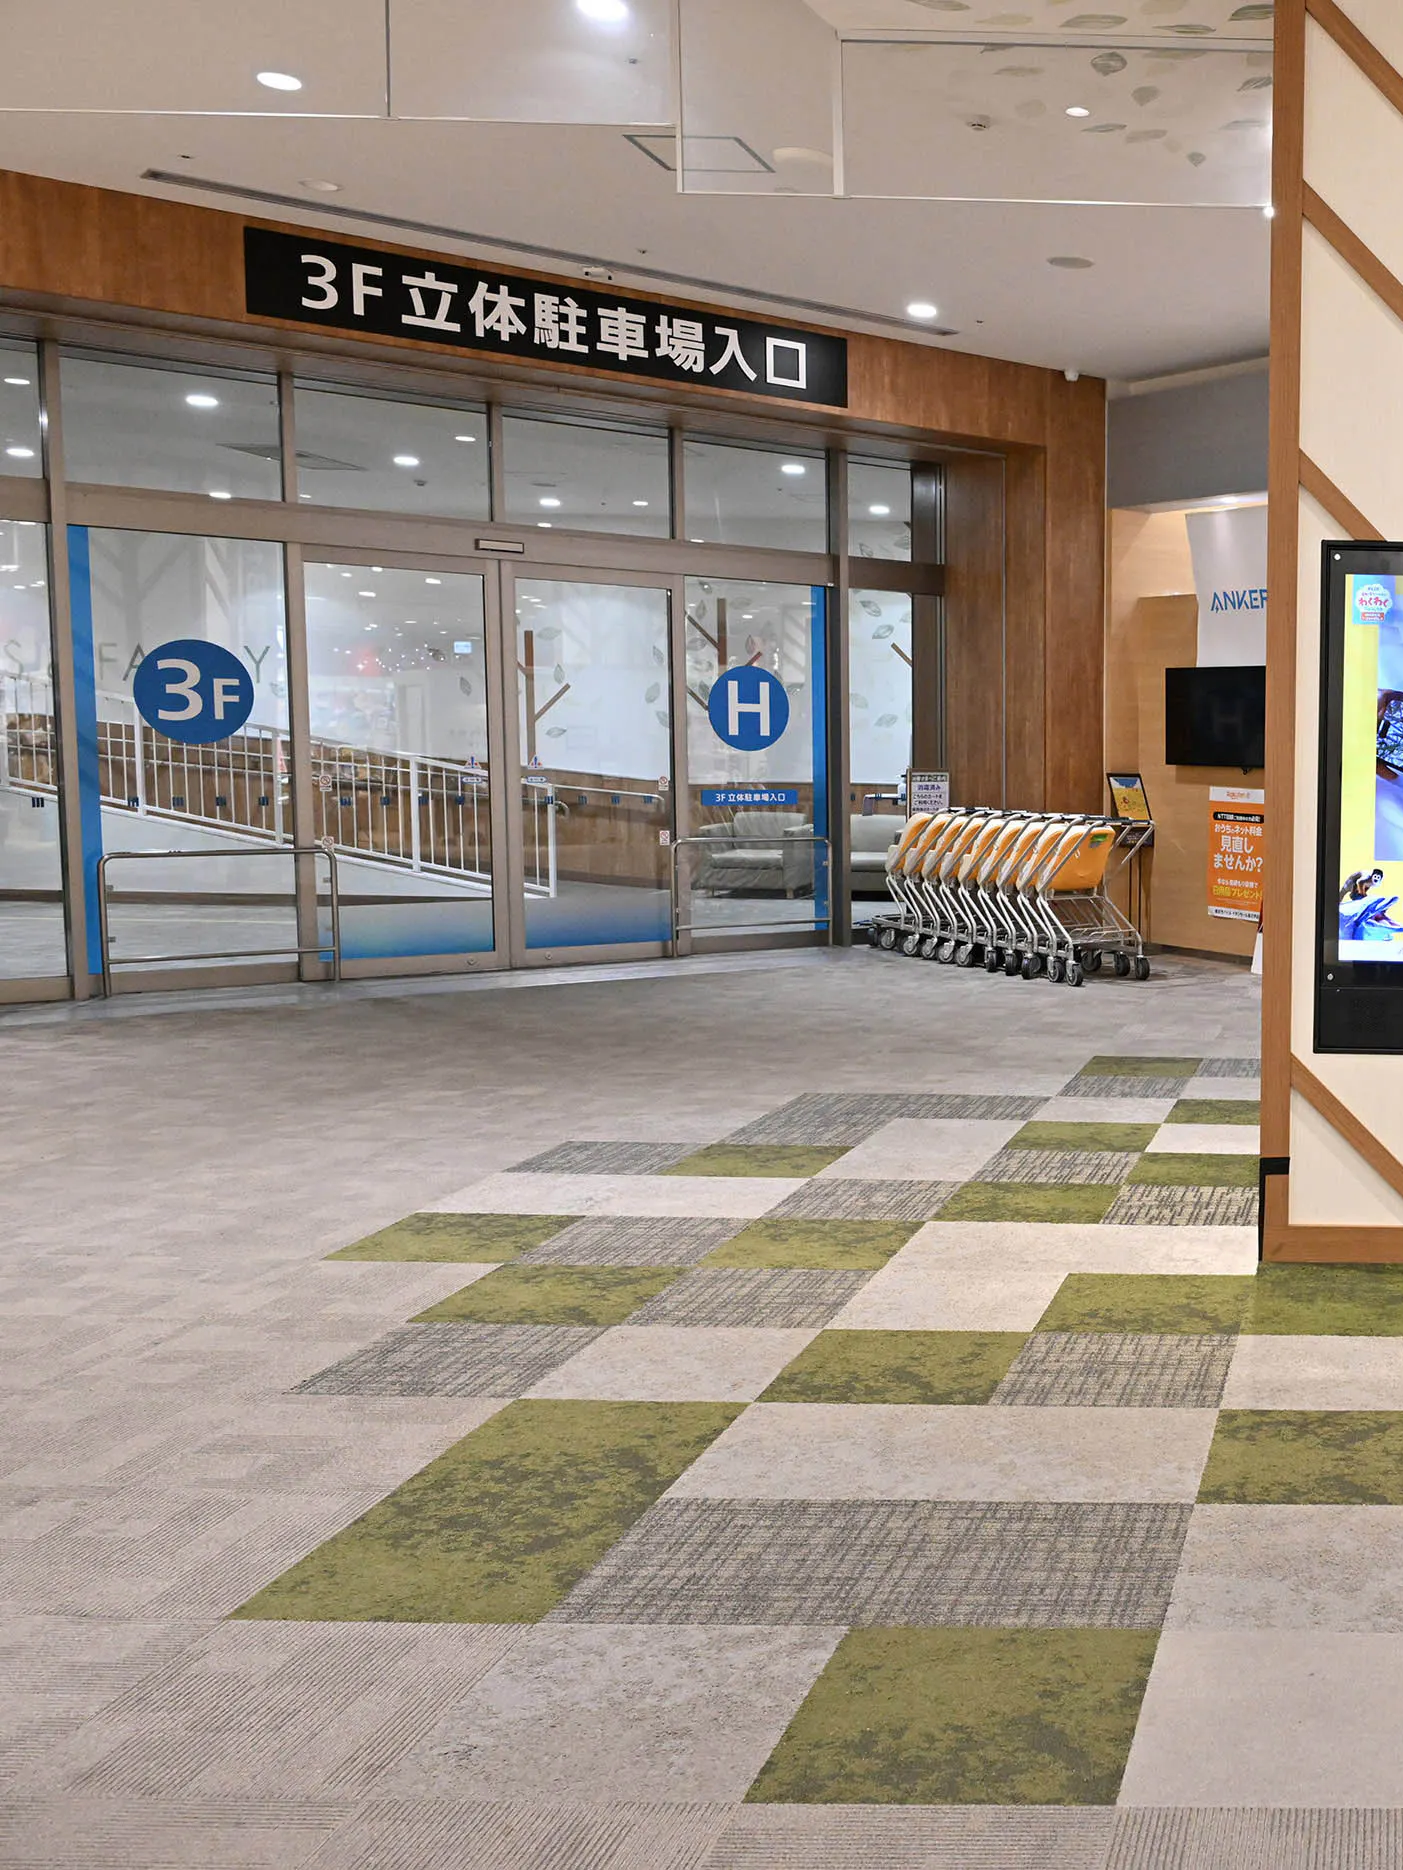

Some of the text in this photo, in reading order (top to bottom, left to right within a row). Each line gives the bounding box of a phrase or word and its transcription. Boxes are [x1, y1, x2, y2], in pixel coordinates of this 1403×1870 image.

[300, 254, 807, 390] 3F 立体駐車場入口
[156, 658, 241, 721] 3F
[727, 680, 771, 737] H
[715, 793, 786, 803] 3F 立体駐車場入口
[1213, 853, 1264, 873] ませんか?
[1221, 835, 1254, 854] 見直し
